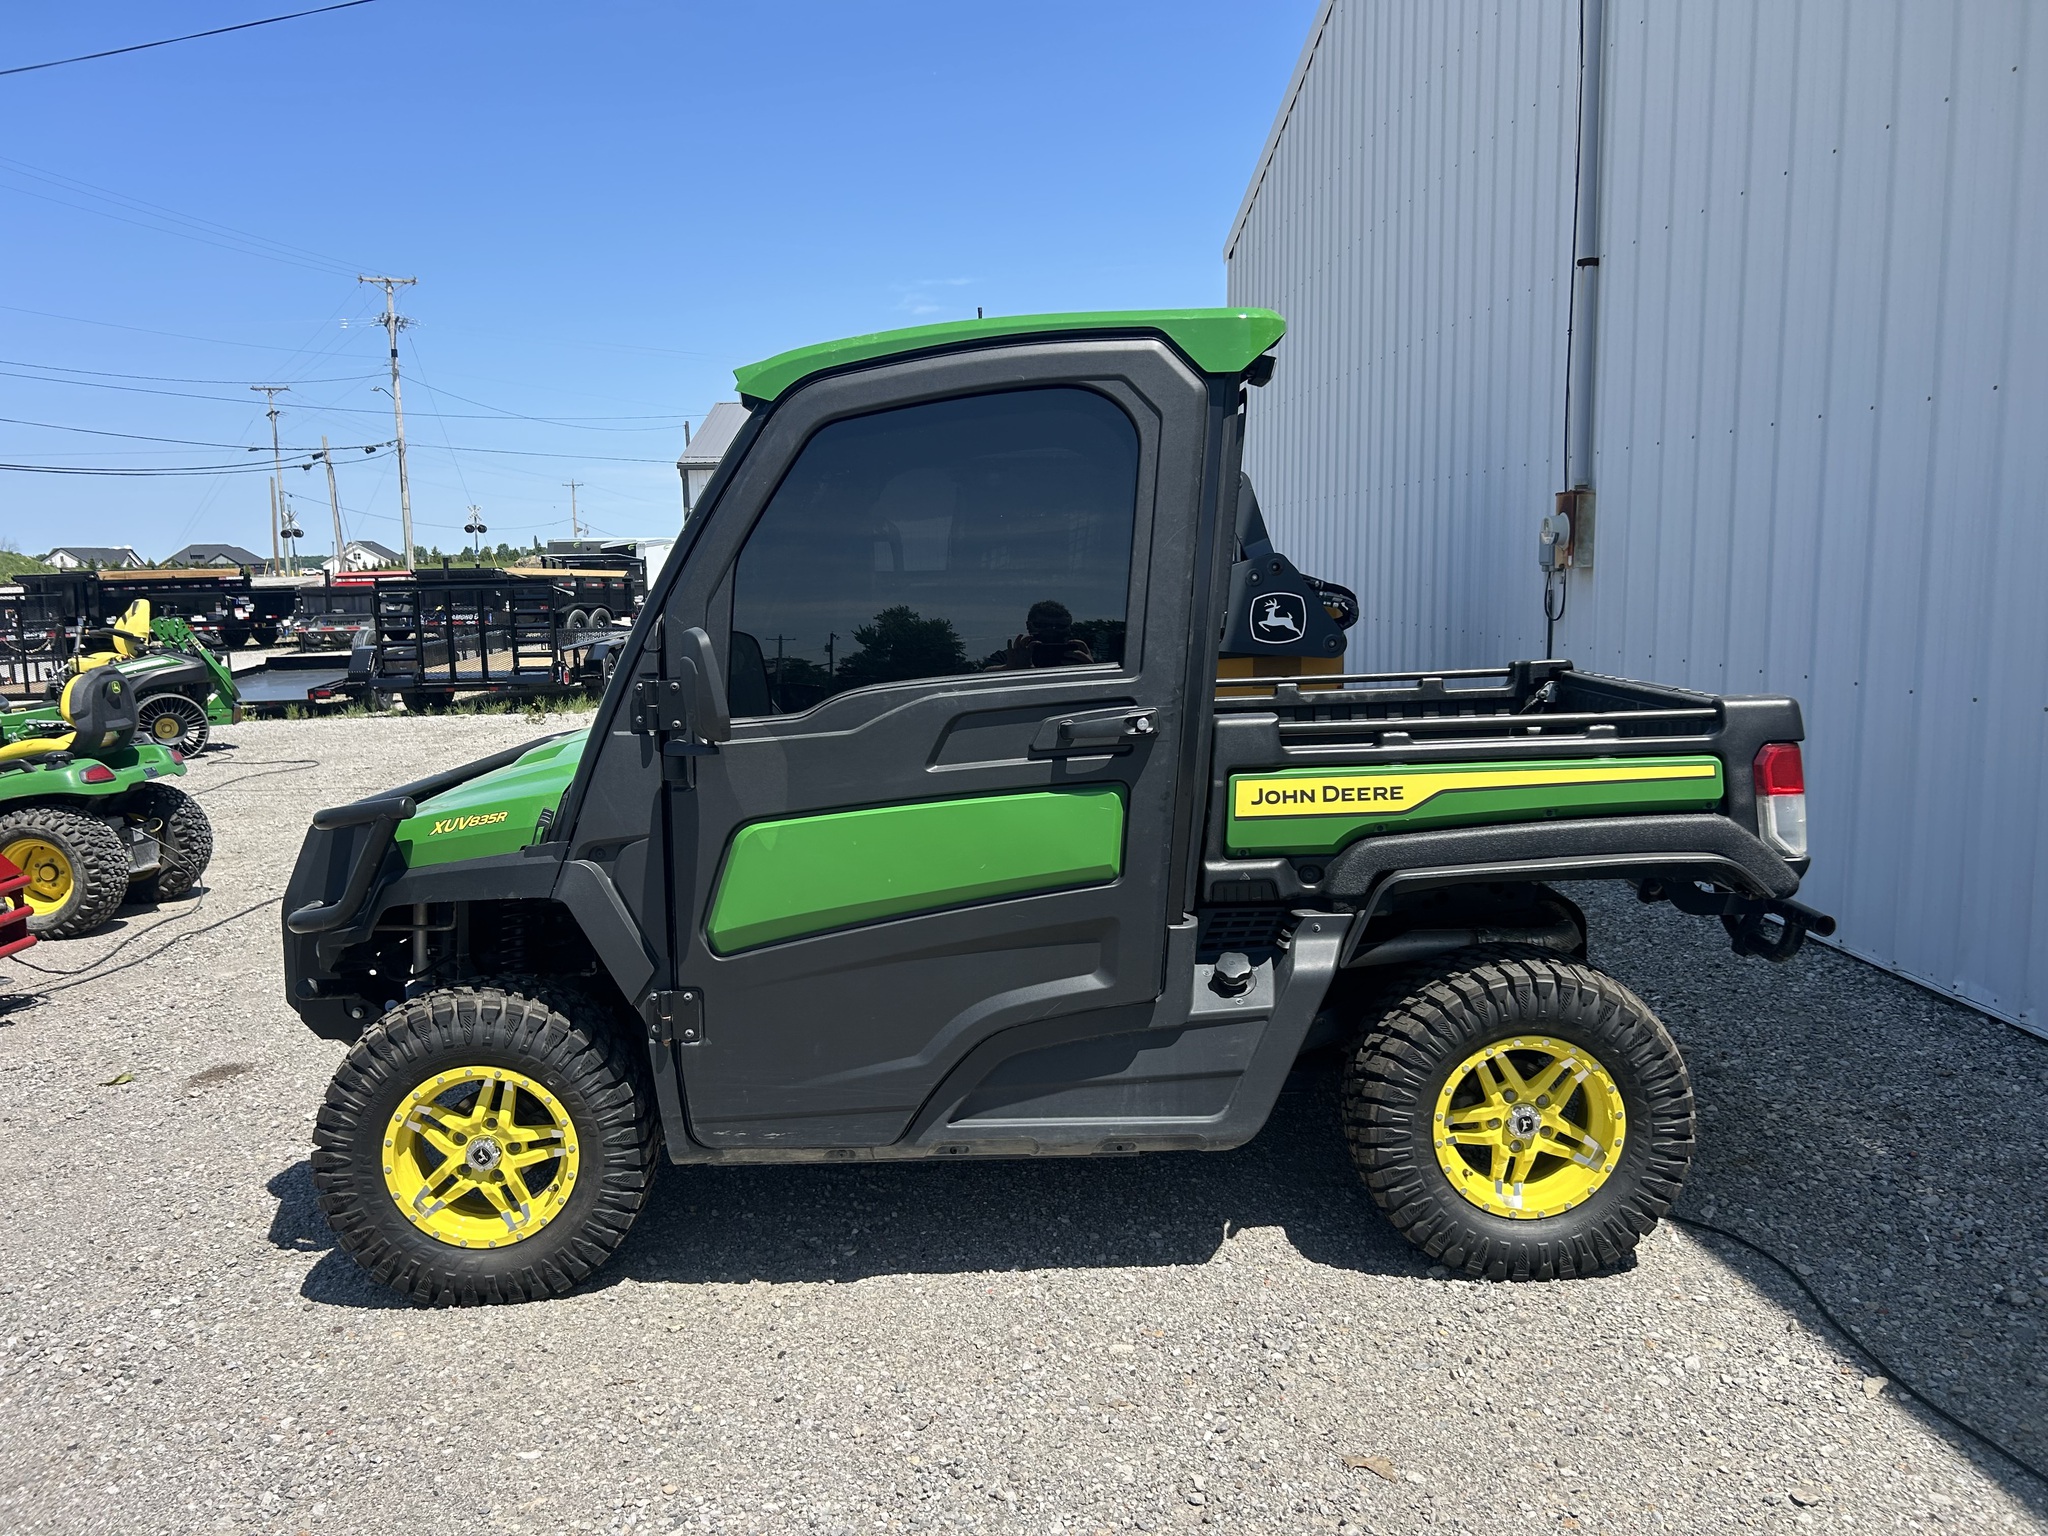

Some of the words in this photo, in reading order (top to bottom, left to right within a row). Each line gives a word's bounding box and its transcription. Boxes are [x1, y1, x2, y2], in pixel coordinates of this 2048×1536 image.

[1251, 788, 1315, 805] JOHN
[1322, 786, 1404, 803] DEERE
[428, 811, 508, 836] XUV835R
